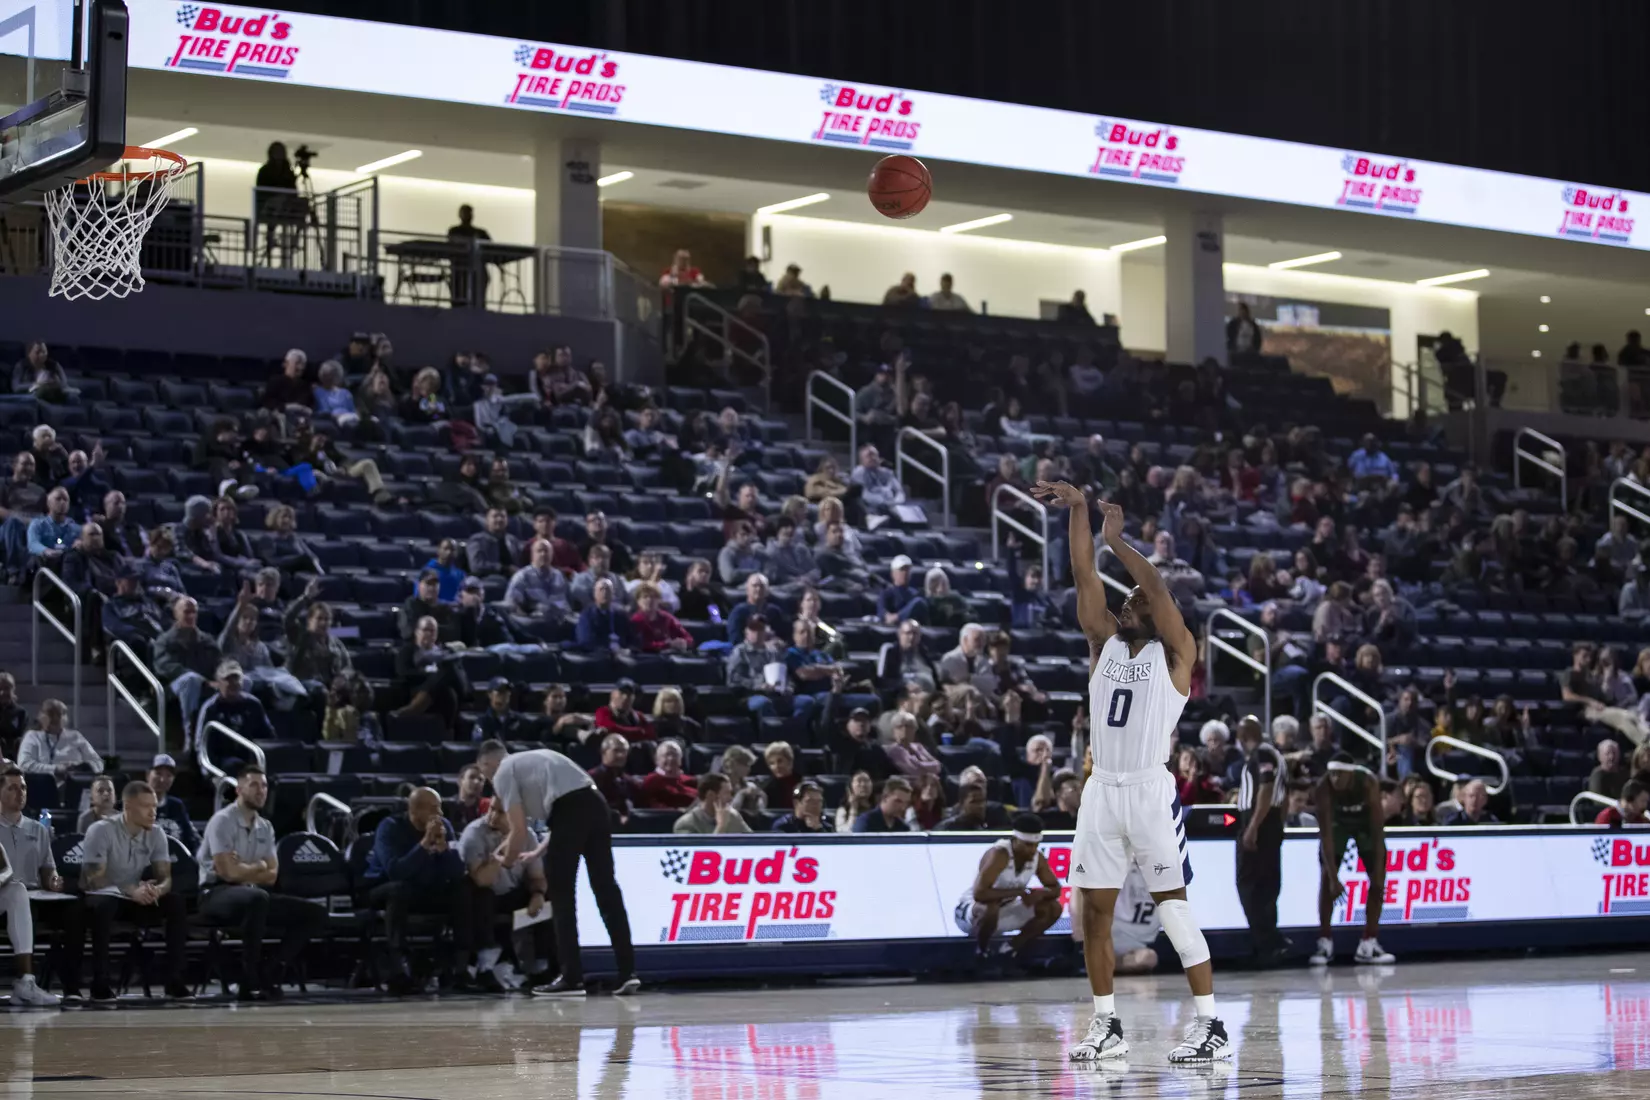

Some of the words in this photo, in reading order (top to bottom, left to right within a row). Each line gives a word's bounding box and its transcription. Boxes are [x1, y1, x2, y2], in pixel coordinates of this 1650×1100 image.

[193, 8, 290, 40] Bud's
[170, 35, 230, 67] TIRE
[226, 41, 299, 72] PROS
[531, 47, 617, 78] Bud's
[510, 73, 563, 103] TIRE
[560, 80, 626, 108] PROS
[835, 87, 913, 115] Bud's
[816, 111, 864, 140] TIRE
[862, 117, 921, 145] PROS
[1109, 123, 1179, 150] Bud's
[1091, 146, 1135, 173] TIRE
[1132, 152, 1186, 178] PROS
[1107, 688, 1133, 728] 0
[687, 846, 820, 885] Bud's
[1356, 836, 1455, 873] ud's
[1345, 880, 1399, 922] TIE
[1404, 877, 1471, 920] PROS
[1602, 874, 1649, 913] TIRE
[668, 892, 743, 942] TIRE
[745, 891, 837, 940] PROS
[1131, 902, 1157, 925] 12
